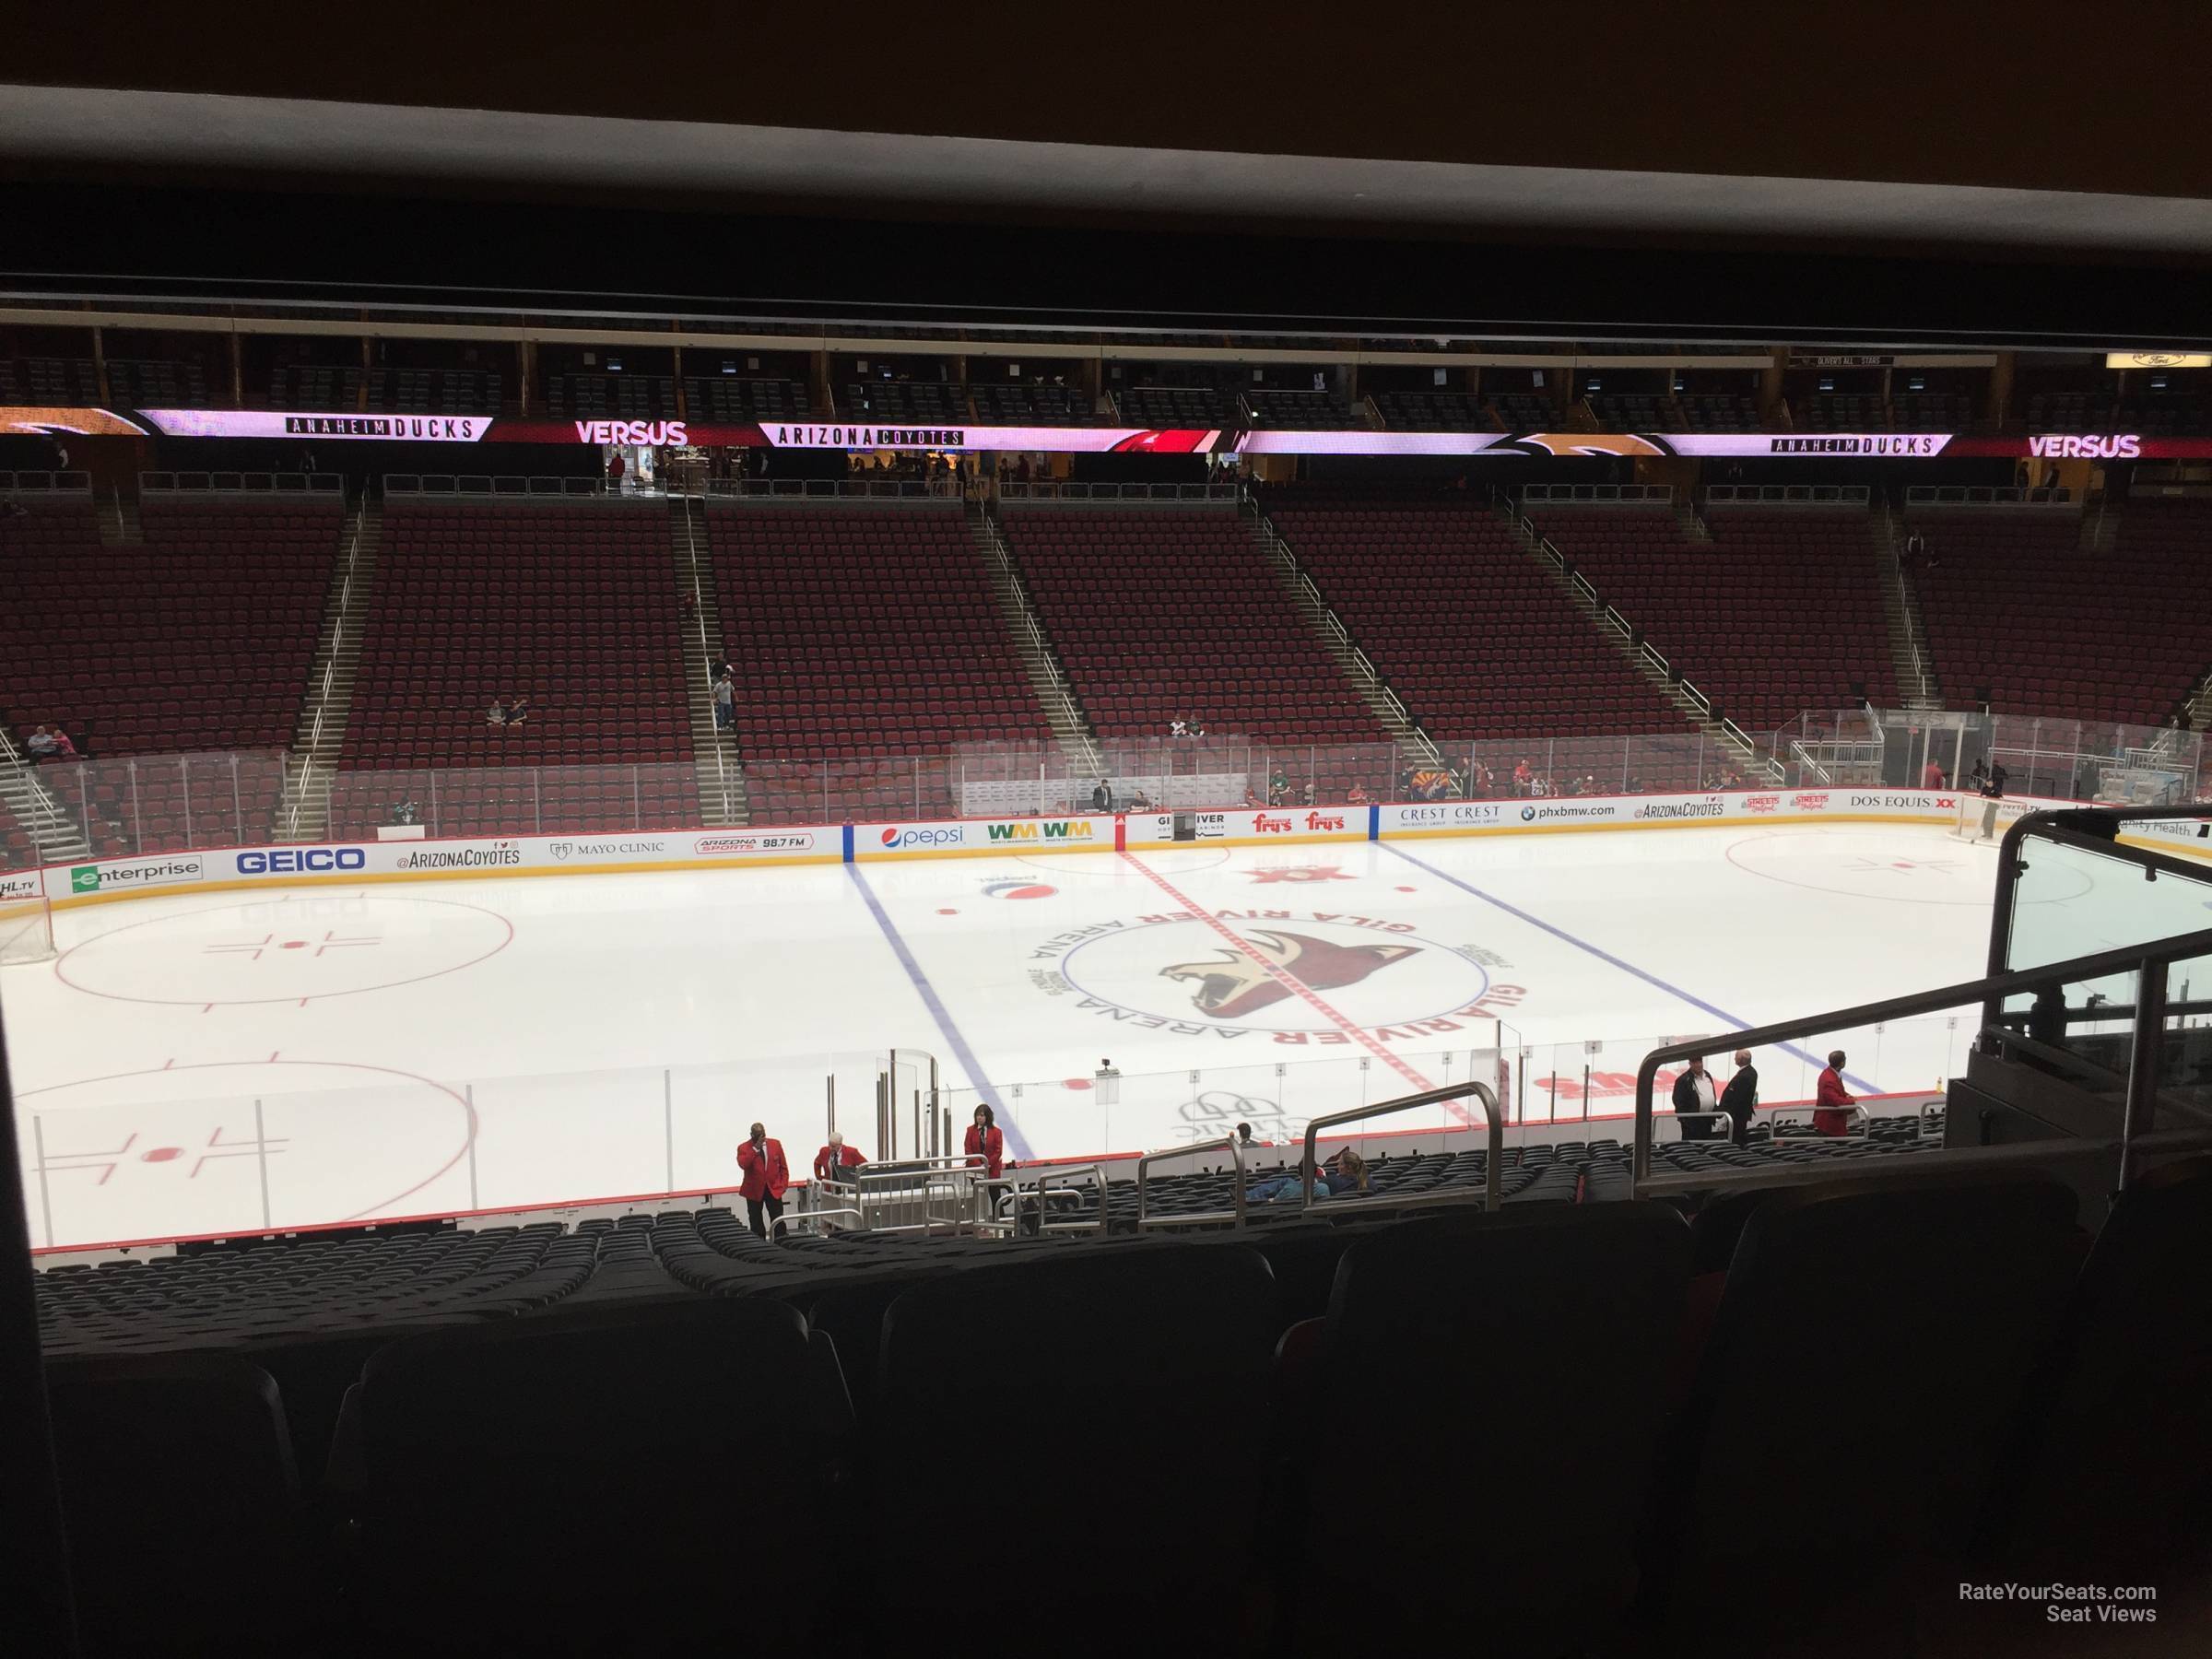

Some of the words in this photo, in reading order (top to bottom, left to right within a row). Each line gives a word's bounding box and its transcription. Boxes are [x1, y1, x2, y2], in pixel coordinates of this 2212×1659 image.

[291, 418, 386, 436] ANAHEIM
[395, 418, 474, 439] DUCKS
[575, 420, 688, 446] VERSUS
[778, 427, 873, 446] ARIZONA
[881, 430, 960, 445] COYOTES
[1775, 439, 1856, 453] ANAHEIM
[1864, 437, 1933, 454] DUCKS
[2029, 434, 2142, 458] VERSUS
[1851, 796, 1880, 806] DOS
[1885, 796, 1931, 807] EQUIS
[1196, 815, 1224, 823] IVER
[1401, 808, 1446, 820] CREST
[1455, 806, 1500, 818] CREST
[1538, 806, 1615, 819] phxbmw.com
[904, 826, 964, 847] pepsi
[2153, 823, 2191, 836] Health
[578, 843, 617, 855] MAYO
[618, 841, 665, 853] CLINIC
[763, 839, 787, 848] 98.7
[789, 838, 805, 846] FM
[237, 849, 366, 874] GEICO
[79, 861, 200, 886] enterprise
[1135, 909, 1291, 924] RIVER
[1312, 912, 1417, 933] GILA
[1028, 920, 1124, 959] ARENA
[1454, 984, 1527, 1019] GILA
[1076, 998, 1250, 1039] ARENA
[1272, 1018, 1466, 1045] RIVER
